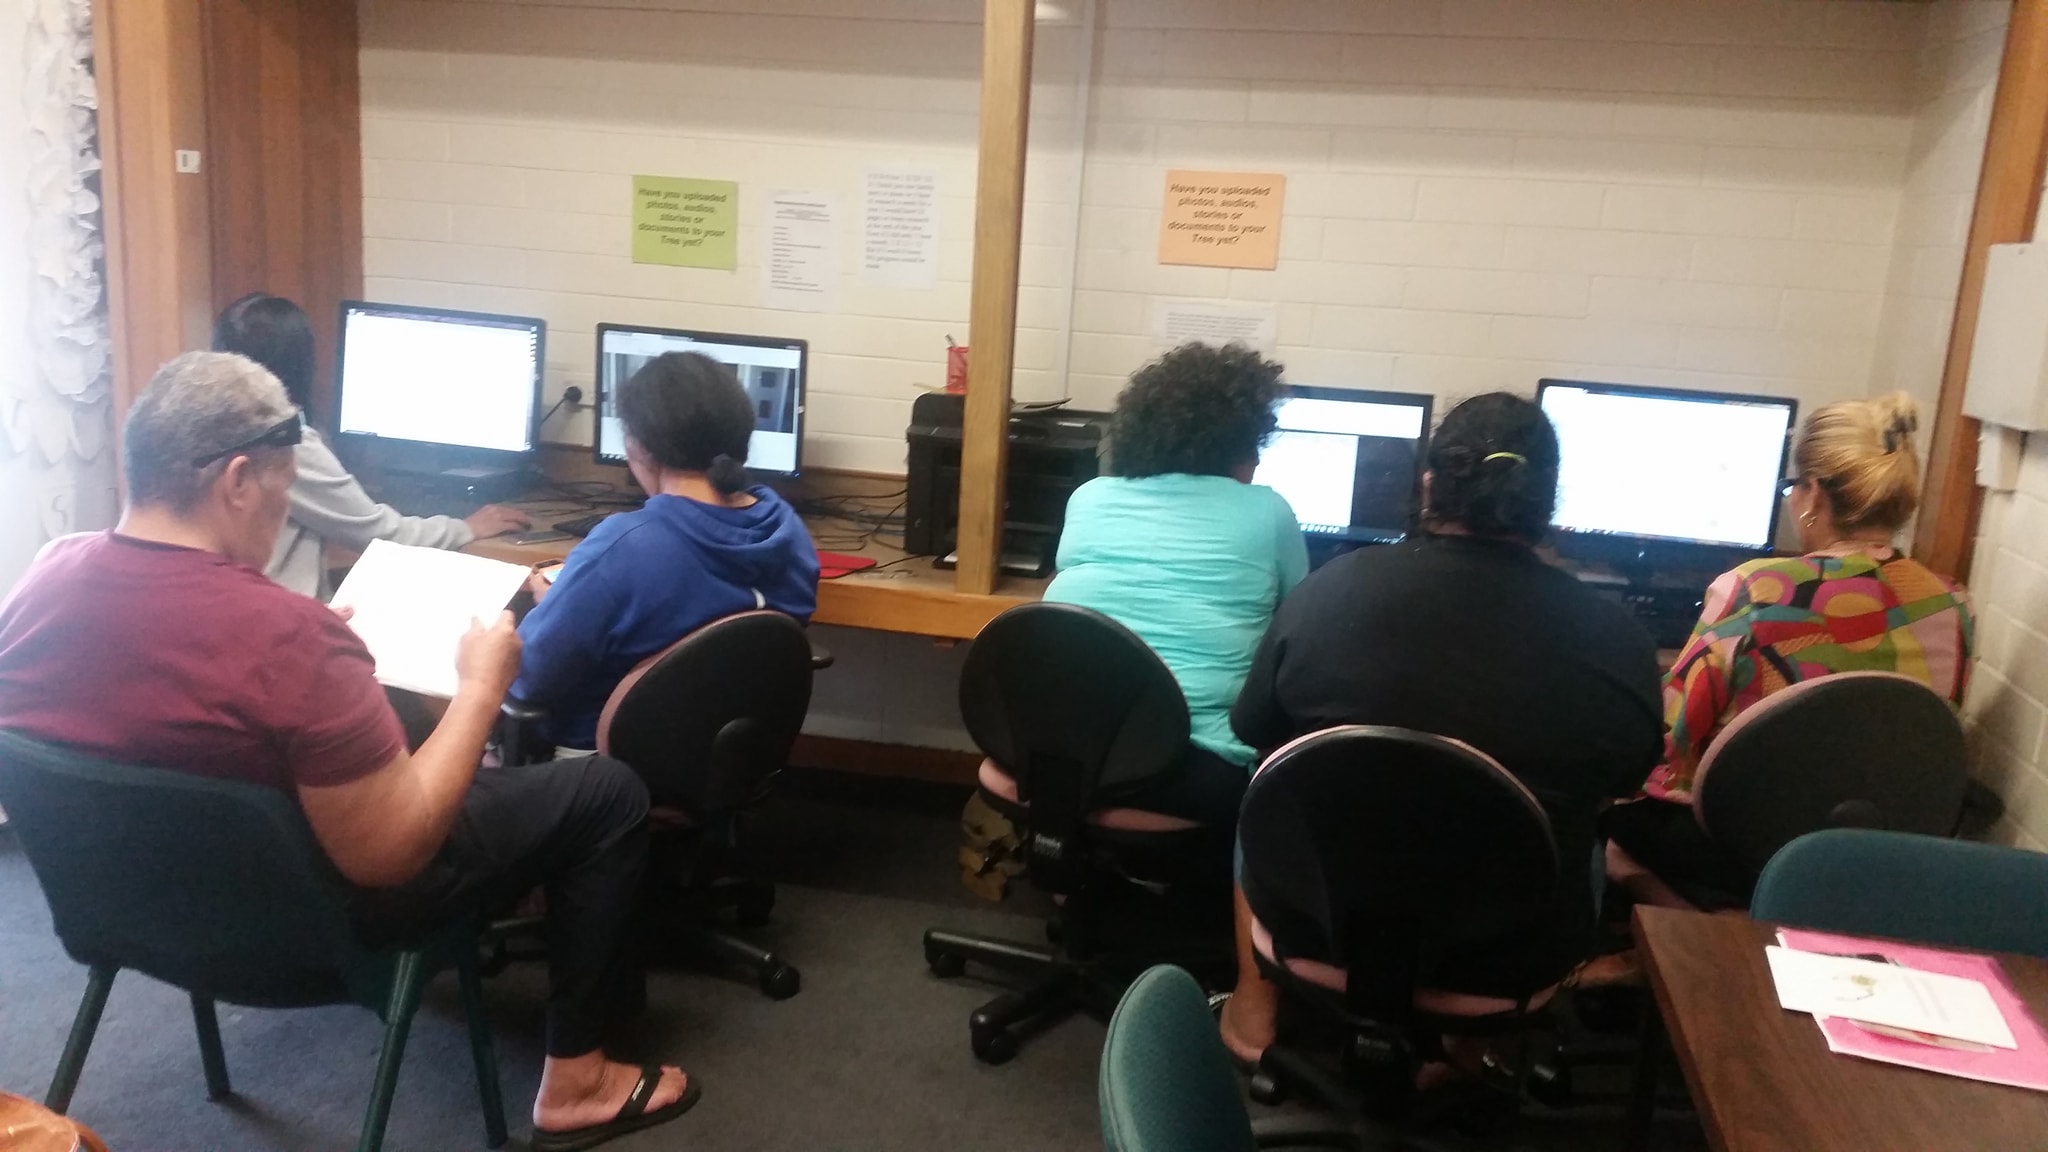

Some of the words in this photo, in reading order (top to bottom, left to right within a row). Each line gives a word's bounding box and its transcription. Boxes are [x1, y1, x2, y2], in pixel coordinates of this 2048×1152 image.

[1169, 183, 1196, 193] Have
[1198, 186, 1219, 196] you
[1220, 186, 1271, 197] uploaded
[1192, 210, 1228, 220] stories
[1230, 212, 1243, 221] or
[1167, 221, 1225, 231] documents
[1227, 223, 1240, 232] to
[1240, 225, 1267, 235] your
[1192, 233, 1215, 244] Tree
[1216, 235, 1240, 247] yet?
